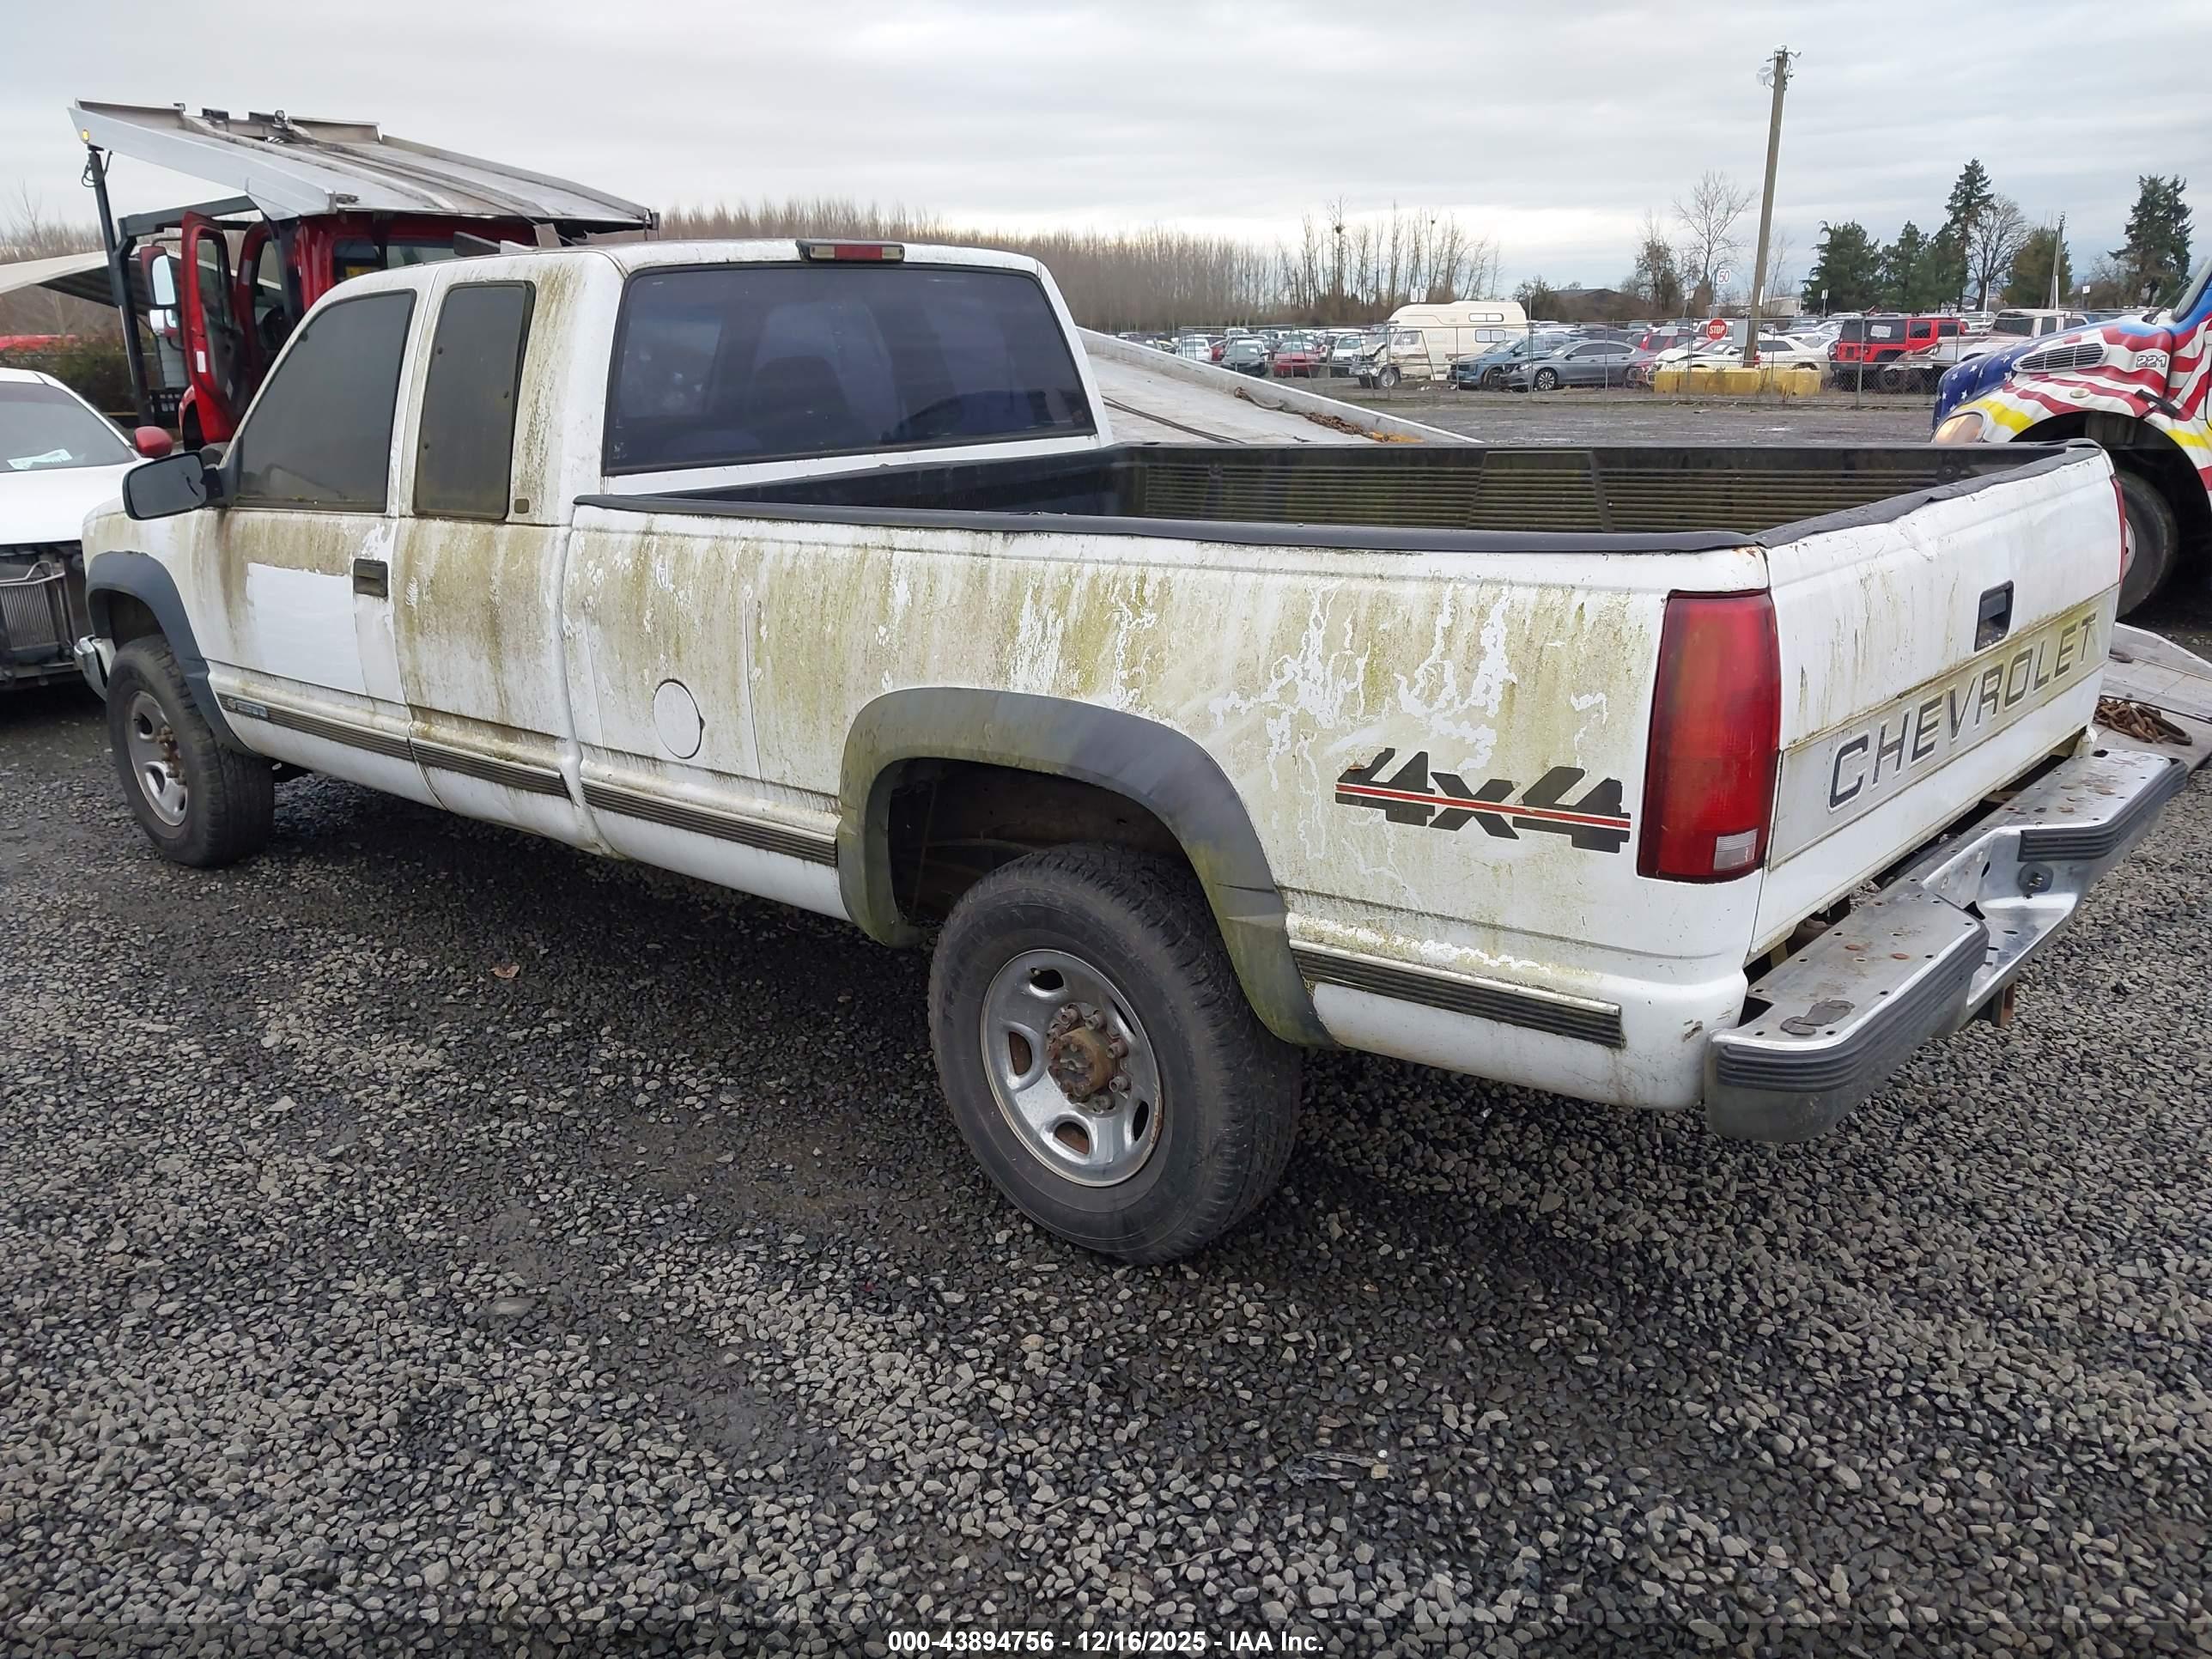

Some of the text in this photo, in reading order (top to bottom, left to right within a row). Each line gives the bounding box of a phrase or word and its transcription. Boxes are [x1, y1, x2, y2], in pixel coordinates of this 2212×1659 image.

[1709, 325, 1725, 334] STOP
[2136, 355, 2166, 368] 221
[1828, 611, 2098, 810] CHEVROLET
